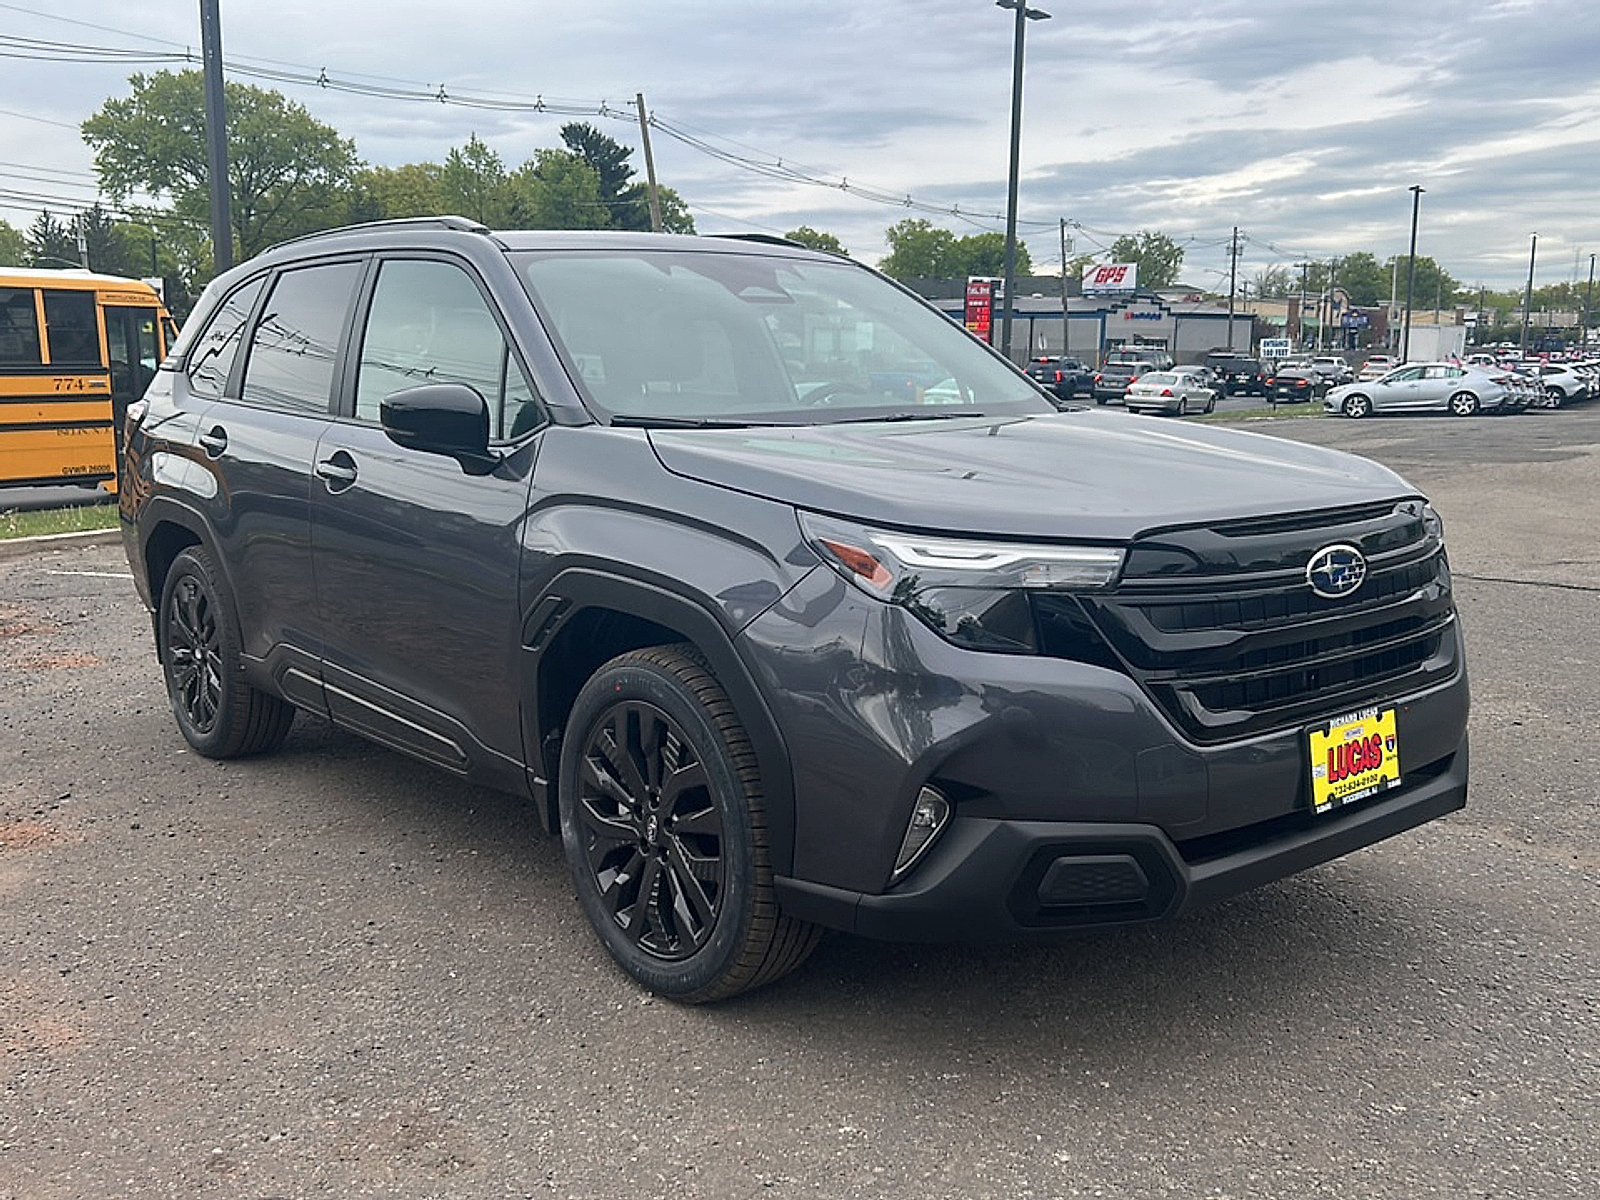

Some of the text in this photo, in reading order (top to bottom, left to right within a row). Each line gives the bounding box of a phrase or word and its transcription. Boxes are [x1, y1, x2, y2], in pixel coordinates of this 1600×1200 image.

[1093, 266, 1128, 283] GPS
[53, 378, 84, 391] 774
[1327, 733, 1383, 784] LUCAS
